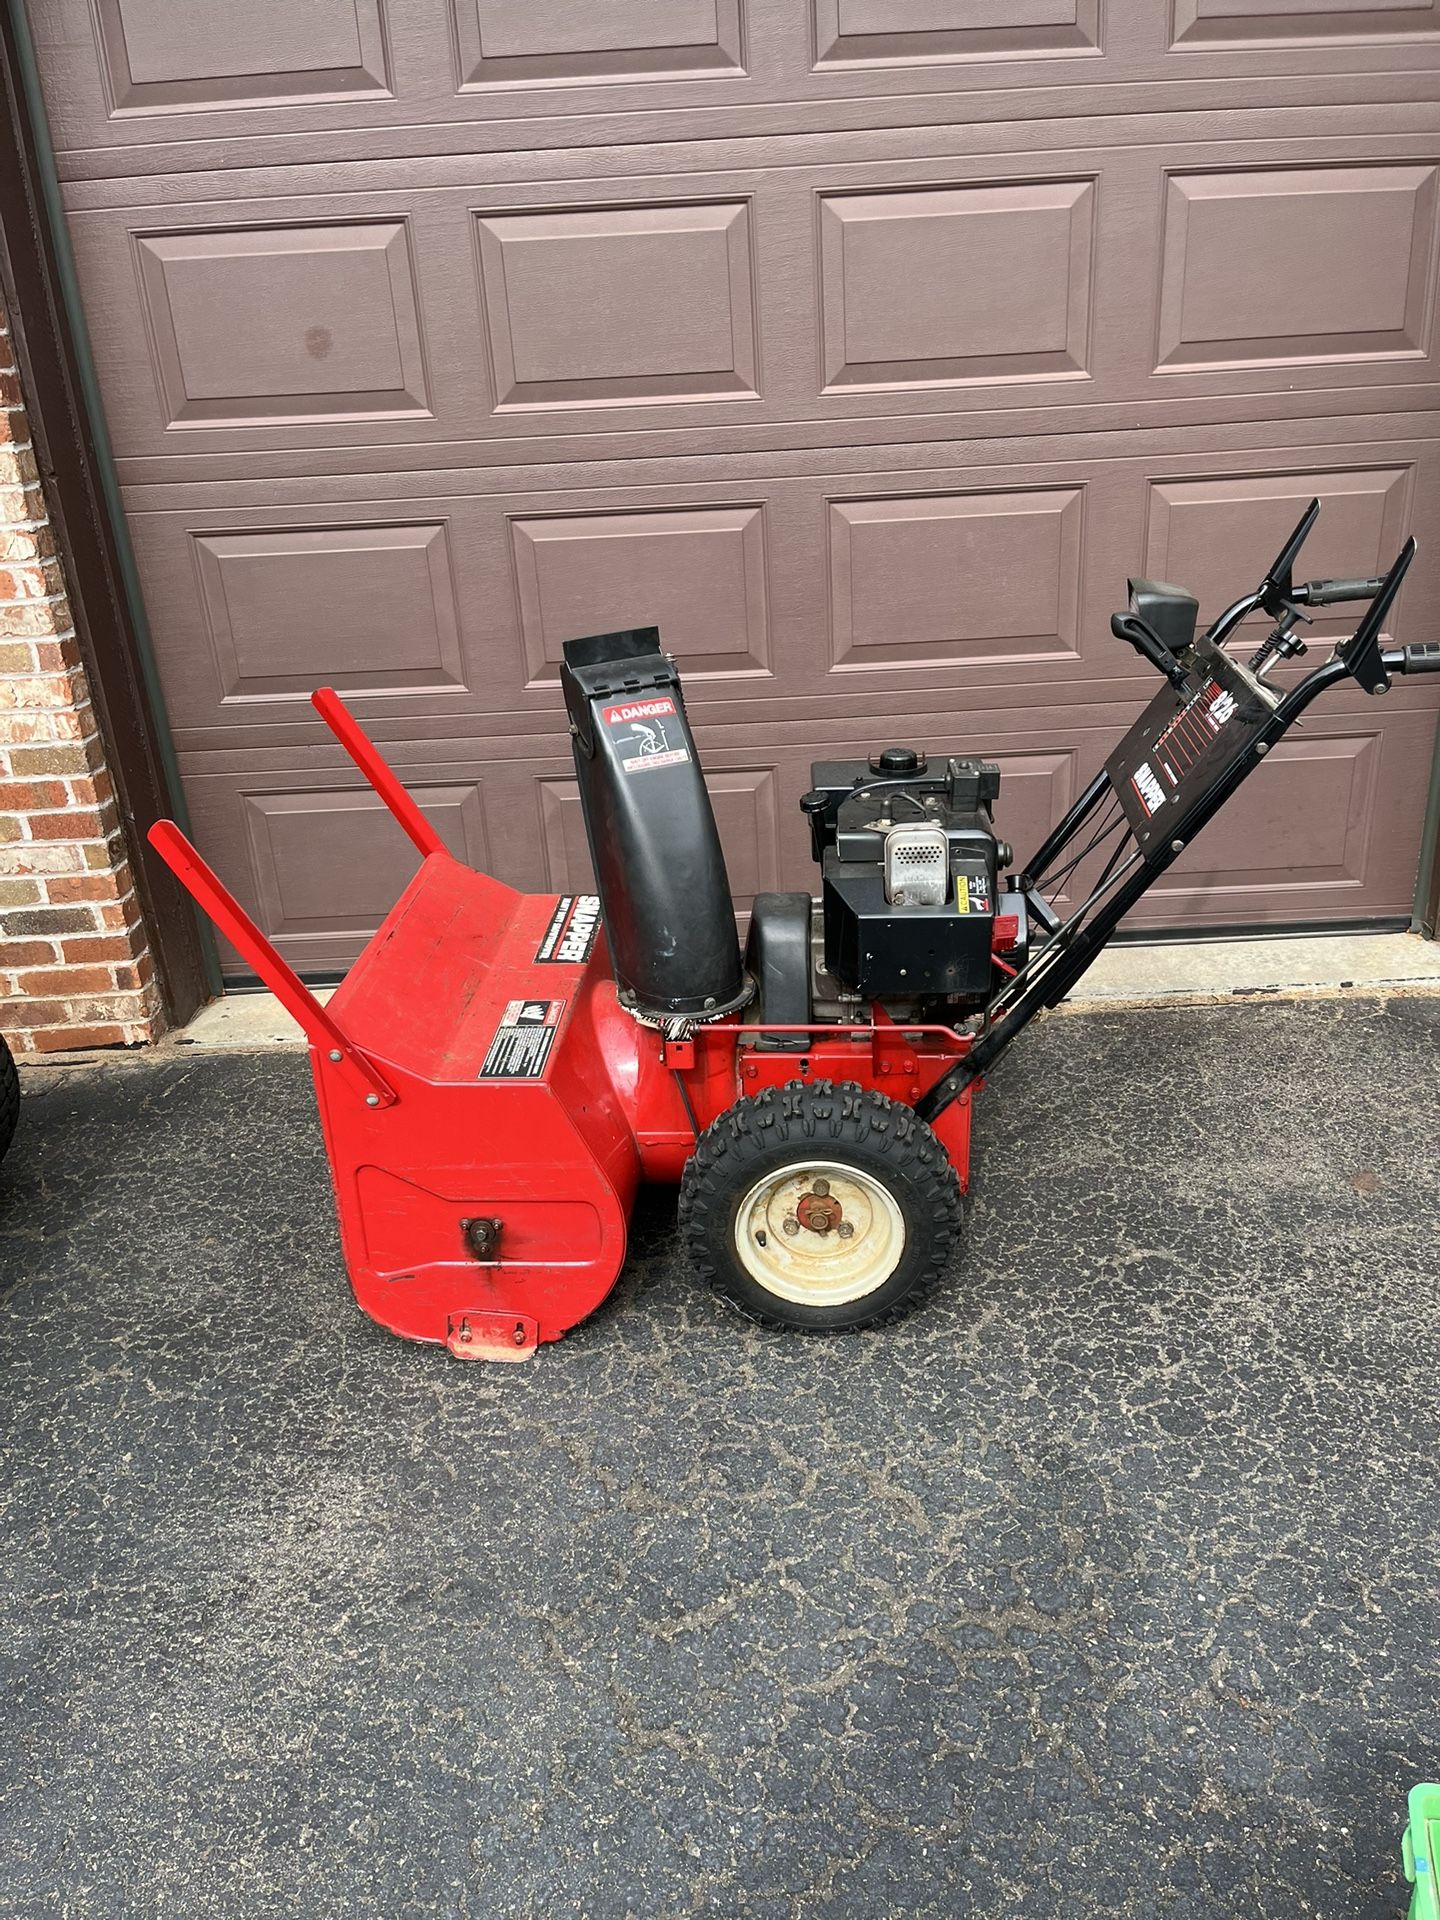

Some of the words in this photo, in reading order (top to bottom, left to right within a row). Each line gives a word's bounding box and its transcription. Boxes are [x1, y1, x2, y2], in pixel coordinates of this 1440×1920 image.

[621, 702, 674, 719] DANGER
[1209, 690, 1239, 724] 826
[1133, 762, 1168, 814] SNAPPER
[959, 877, 968, 906] CAUTION
[556, 895, 601, 960] SNAPPER
